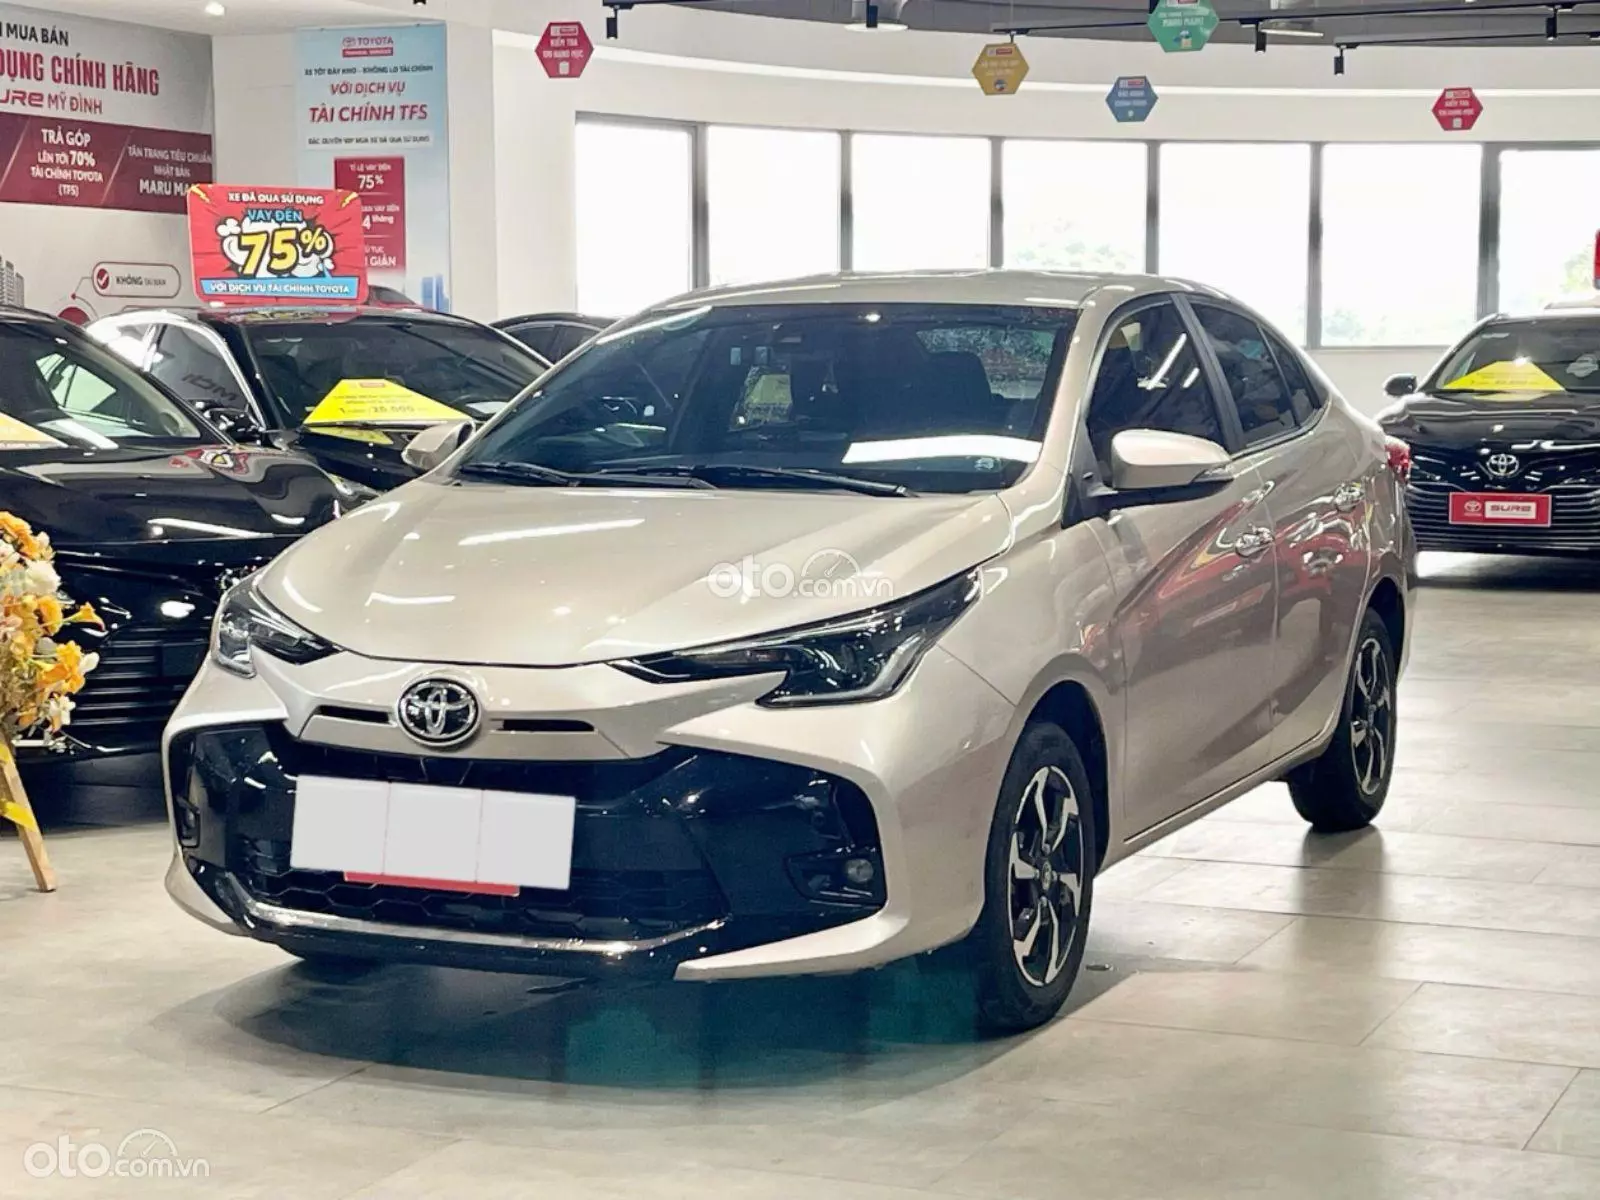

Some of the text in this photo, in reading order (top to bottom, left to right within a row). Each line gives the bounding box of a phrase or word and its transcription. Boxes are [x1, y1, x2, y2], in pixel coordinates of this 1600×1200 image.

[6, 22, 38, 42] MUA
[41, 25, 69, 46] BÁN
[358, 36, 394, 46] TOYOTA
[51, 52, 106, 89] CHÍNH
[112, 61, 160, 96] HÃNG
[330, 80, 406, 98] VỚI DỊCH VỤ
[0, 88, 102, 114] URE MỸ ĐÌNH
[309, 101, 428, 122] TÀI CHÍNH TFS
[41, 126, 90, 147] TRẢ GÓP
[38, 149, 54, 164] LÊN
[70, 150, 96, 167] 70%
[30, 164, 104, 184] TÀI CHÍNH TOYOTA
[358, 174, 384, 189] 75%
[58, 184, 79, 197] (TFS)
[140, 178, 190, 196] MARU MA
[228, 192, 324, 206] XE ĐÃ QUA SỬ DỤNG
[248, 206, 303, 222] VAY ĐẾN
[239, 227, 328, 276] 75%
[370, 252, 396, 266] GIẢN
[115, 274, 143, 286] KHÔNG
[210, 281, 227, 292] VỚI
[229, 282, 251, 293] DỊCH
[316, 285, 349, 293] TOYOTA
